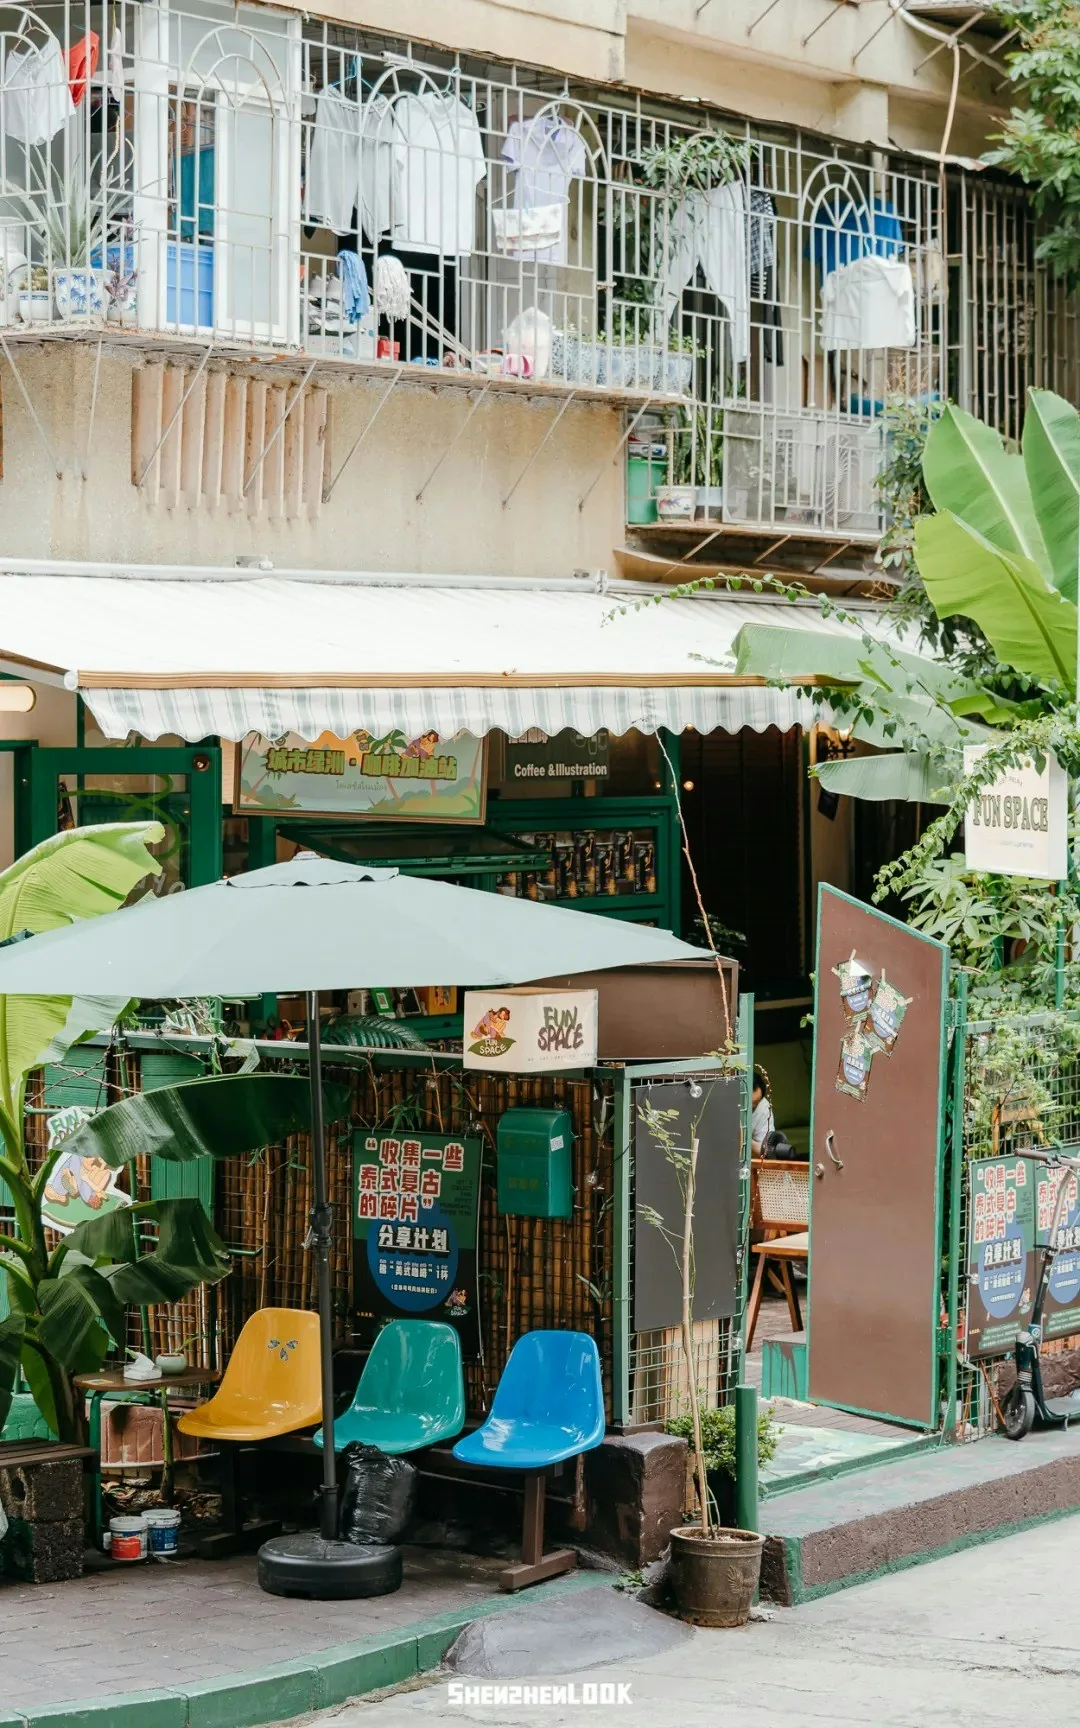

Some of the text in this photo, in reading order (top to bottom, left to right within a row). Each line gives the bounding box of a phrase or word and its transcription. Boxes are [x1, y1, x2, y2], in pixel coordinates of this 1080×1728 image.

[514, 764, 546, 777] Coffee
[973, 793, 1048, 832] FUN SPACE
[543, 1006, 578, 1029] FUN
[479, 1043, 507, 1055] SPACE
[484, 1038, 498, 1047] FUN
[538, 1023, 584, 1052] SPACE
[51, 1109, 80, 1136] FUN
[365, 1138, 465, 1172] “收集一些
[359, 1164, 441, 1197] 泰式复古
[379, 1224, 448, 1251] 分享计划
